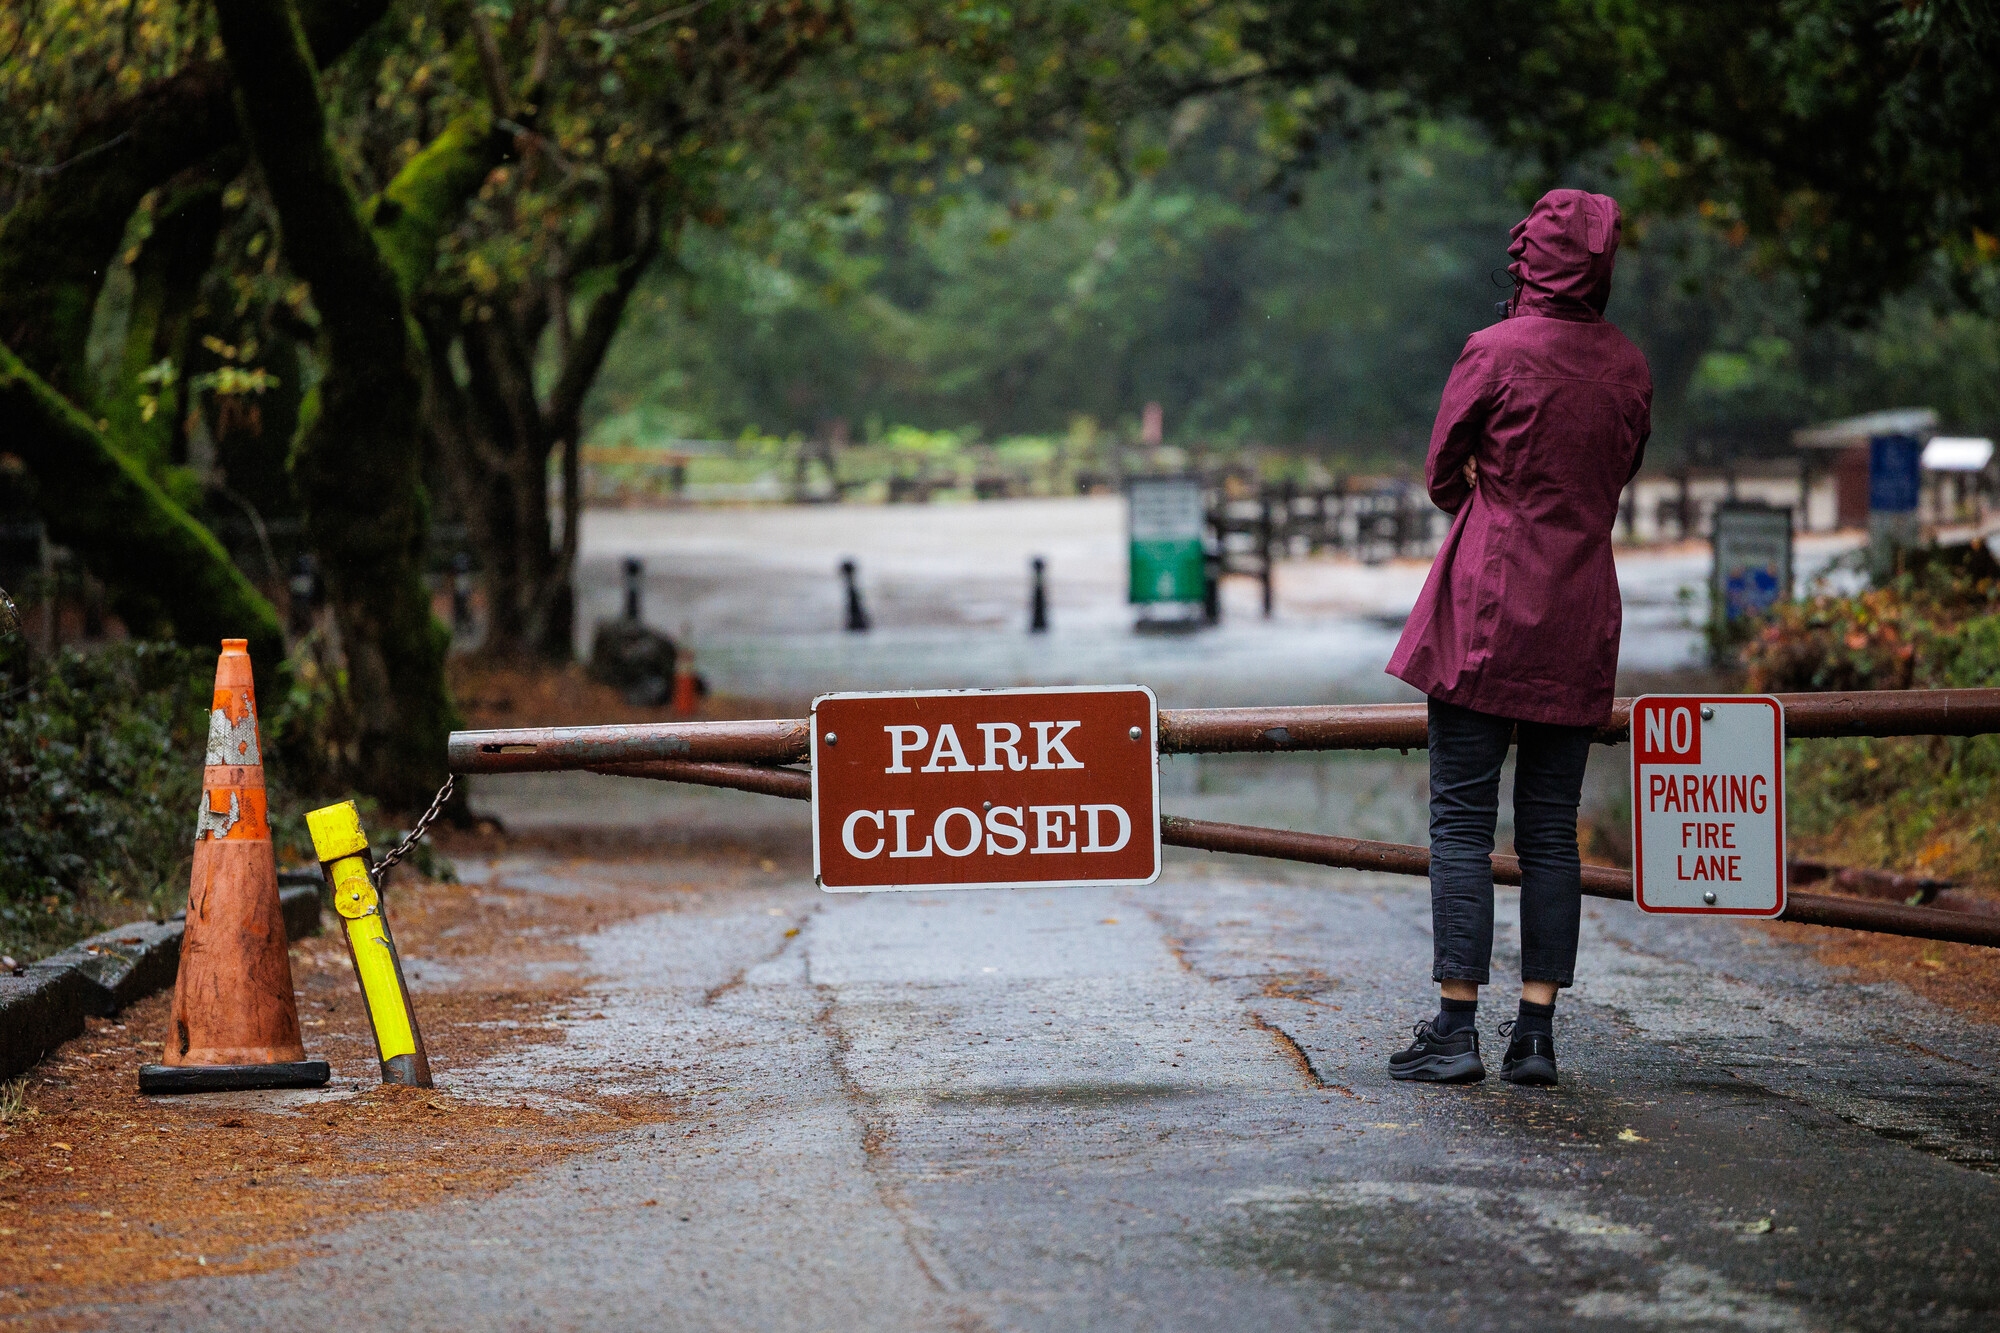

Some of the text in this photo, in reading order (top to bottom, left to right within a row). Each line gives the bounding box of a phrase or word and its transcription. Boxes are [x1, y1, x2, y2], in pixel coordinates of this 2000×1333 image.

[883, 720, 1085, 774] PARK
[1644, 706, 1693, 755] NO
[1649, 774, 1767, 815] PARKING
[841, 802, 1132, 860] CLOSED
[1682, 822, 1736, 849] FIRE
[1677, 855, 1742, 882] LANE
